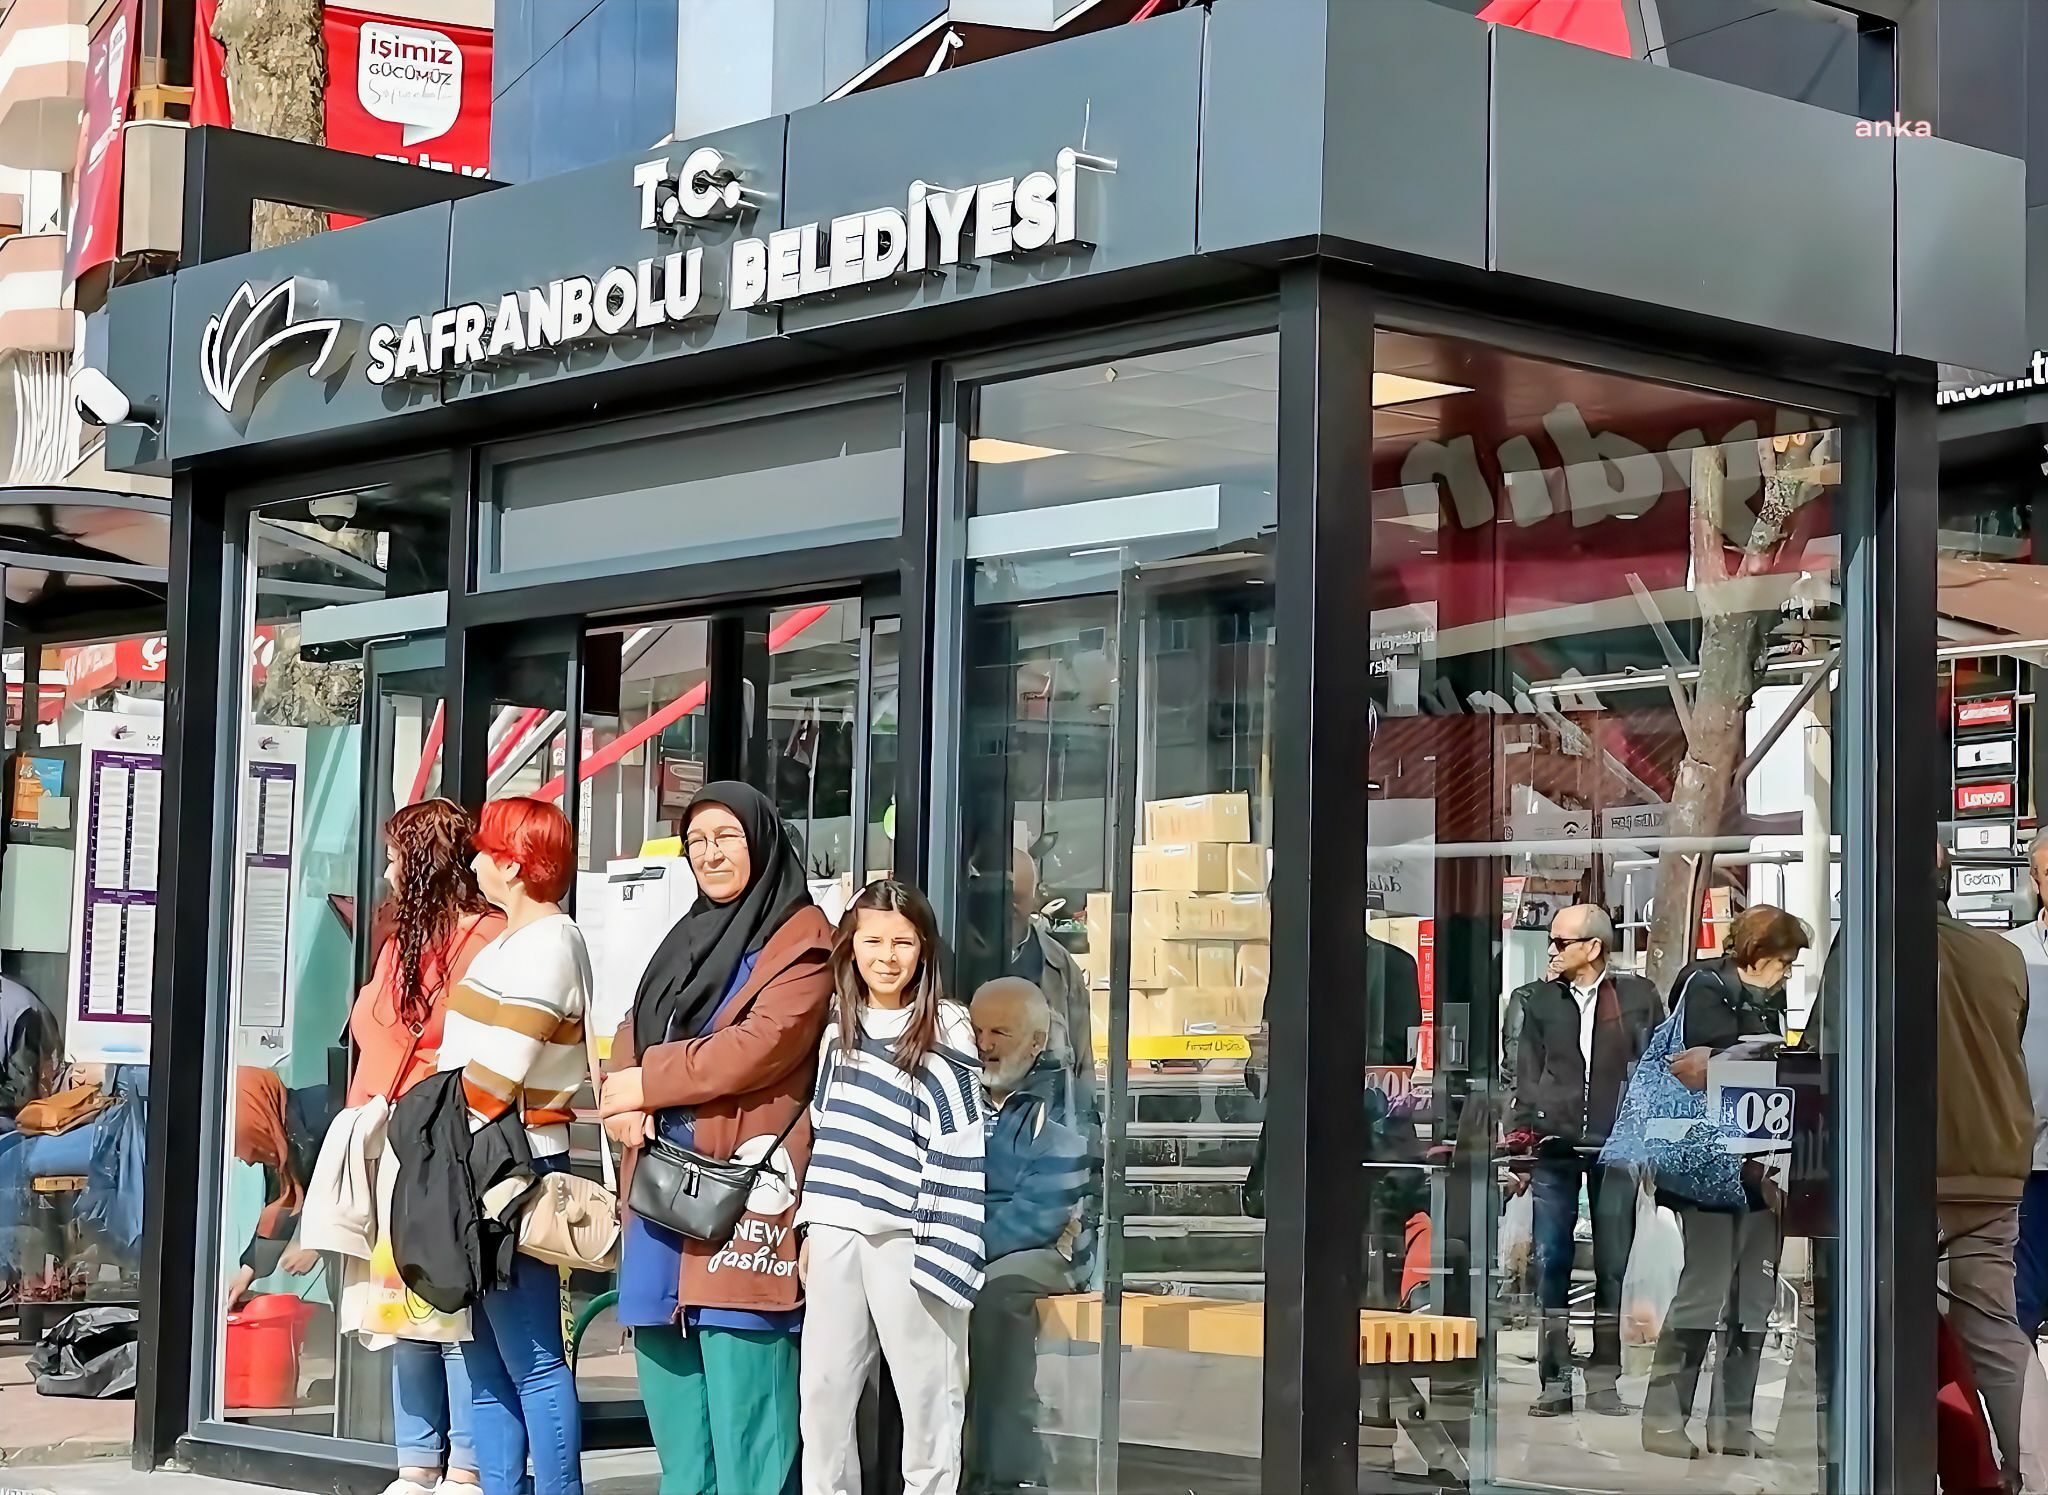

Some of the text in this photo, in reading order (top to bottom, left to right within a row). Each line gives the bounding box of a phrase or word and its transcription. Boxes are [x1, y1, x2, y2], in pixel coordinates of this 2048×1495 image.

[633, 147, 741, 230] T.C.
[365, 146, 1077, 385] SAFRANBOLU BELEDİYESİ
[733, 1219, 788, 1247] NEW
